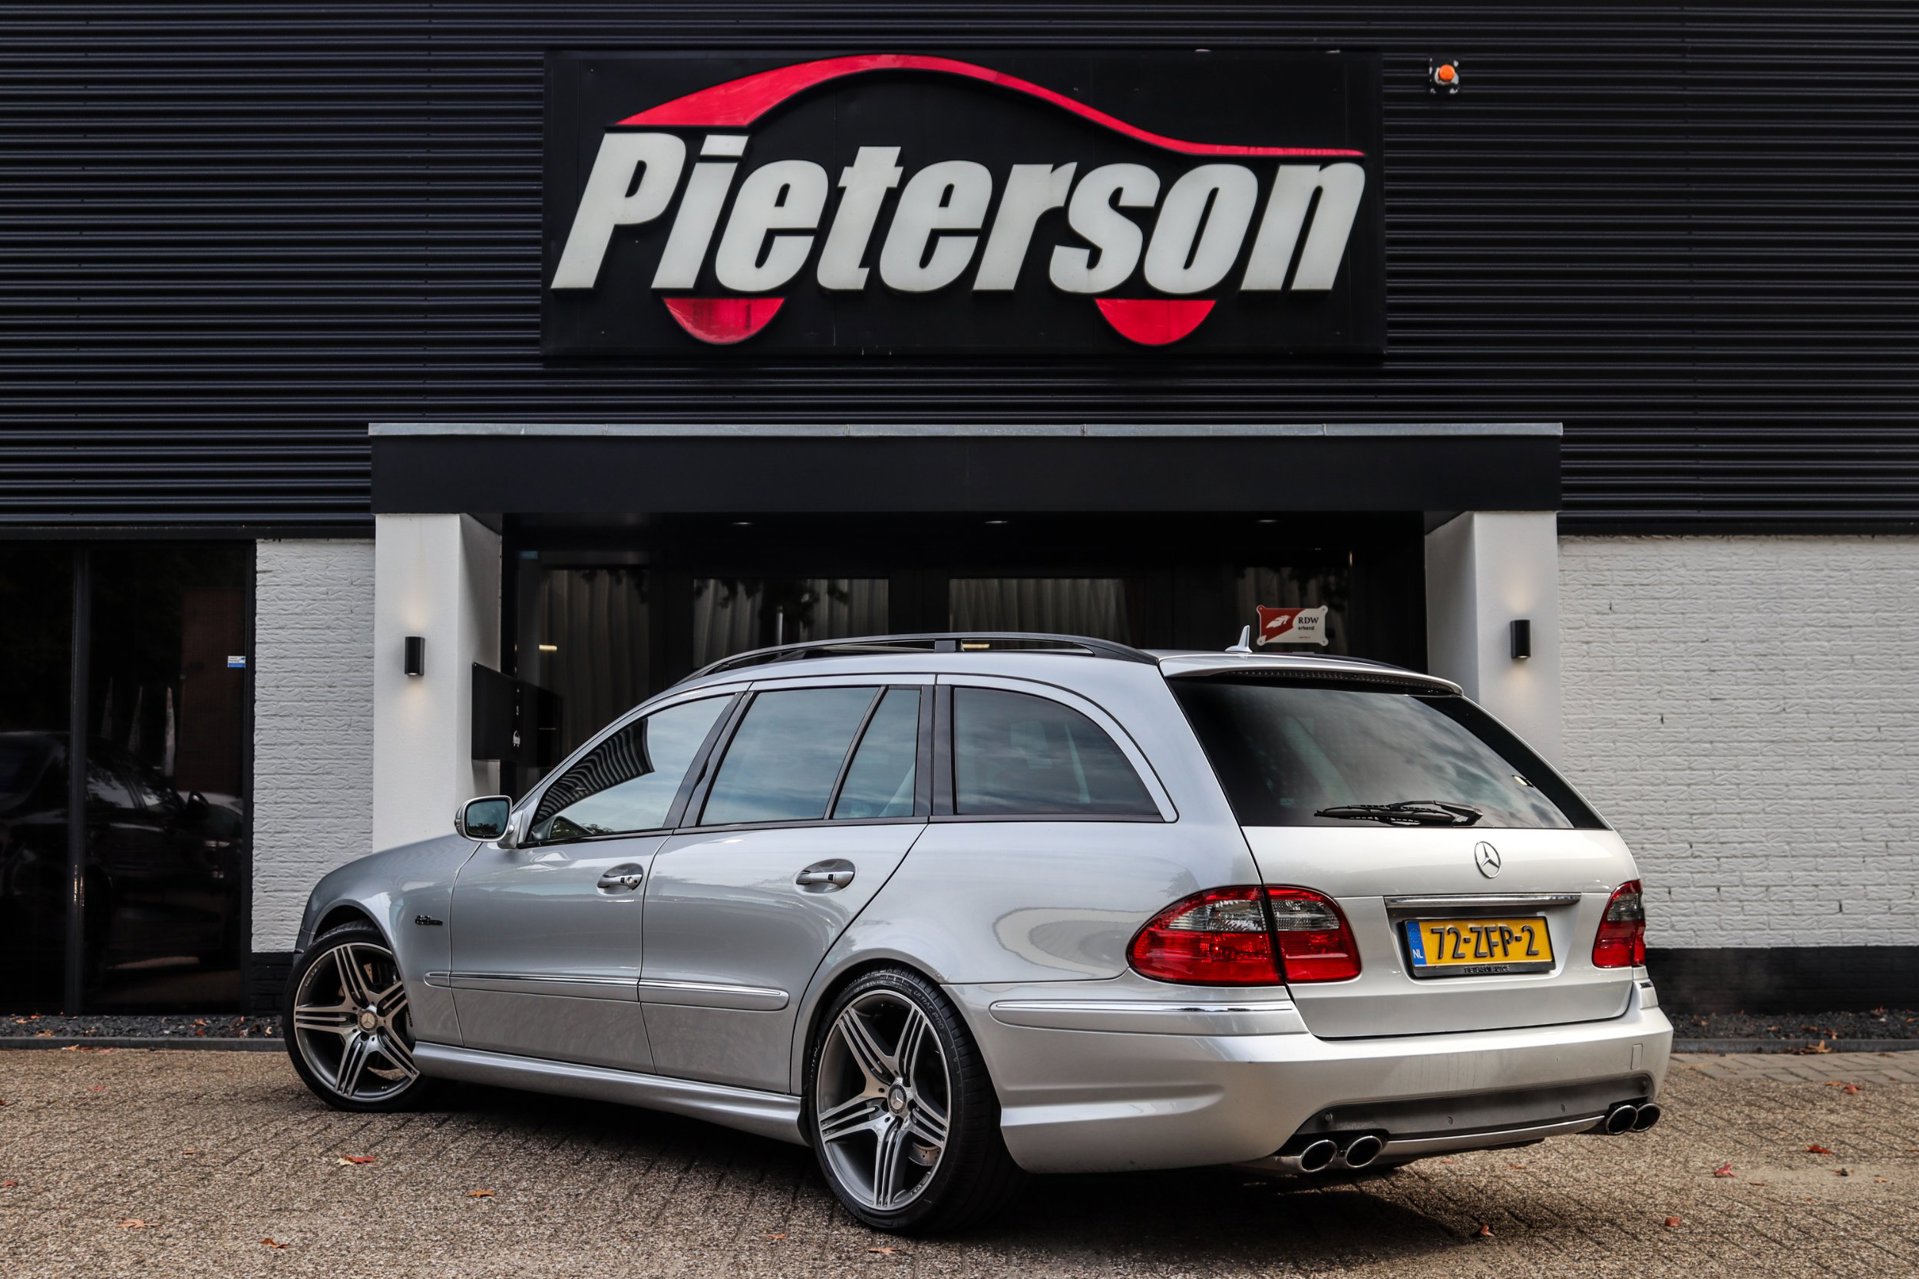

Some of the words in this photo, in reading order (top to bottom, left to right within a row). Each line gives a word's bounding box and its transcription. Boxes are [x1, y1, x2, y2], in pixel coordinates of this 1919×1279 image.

[550, 131, 1366, 295] Pieterson
[1298, 616, 1319, 625] RDW
[1412, 948, 1424, 959] NL
[1430, 924, 1540, 960] 72-ZFP-2
